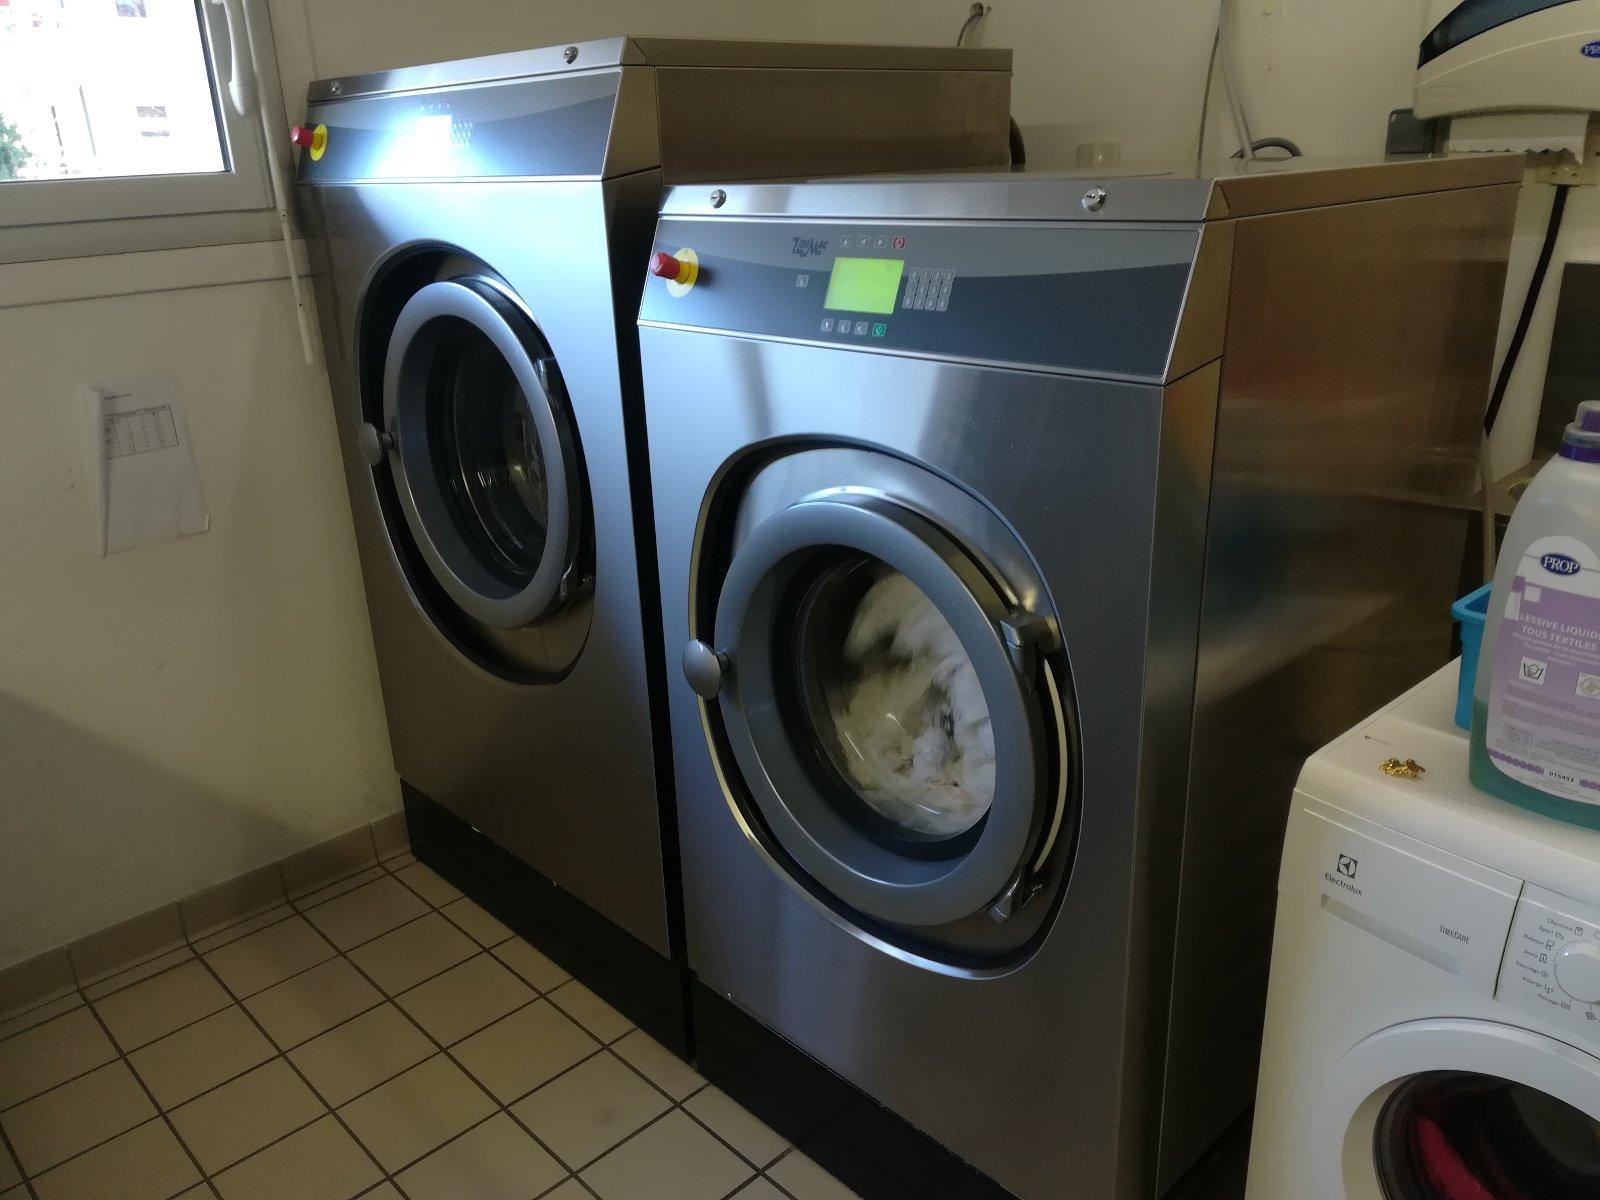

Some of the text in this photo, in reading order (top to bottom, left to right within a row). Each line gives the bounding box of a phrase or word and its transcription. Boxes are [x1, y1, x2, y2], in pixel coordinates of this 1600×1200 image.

[1543, 555, 1579, 574] PROP
[1520, 613, 1558, 630] LESSIVE
[1522, 626, 1548, 640] TOUS
[1550, 632, 1598, 651] TEXTILES
[1324, 872, 1363, 896] Electrolux
[1439, 924, 1471, 944] TIMECARE
